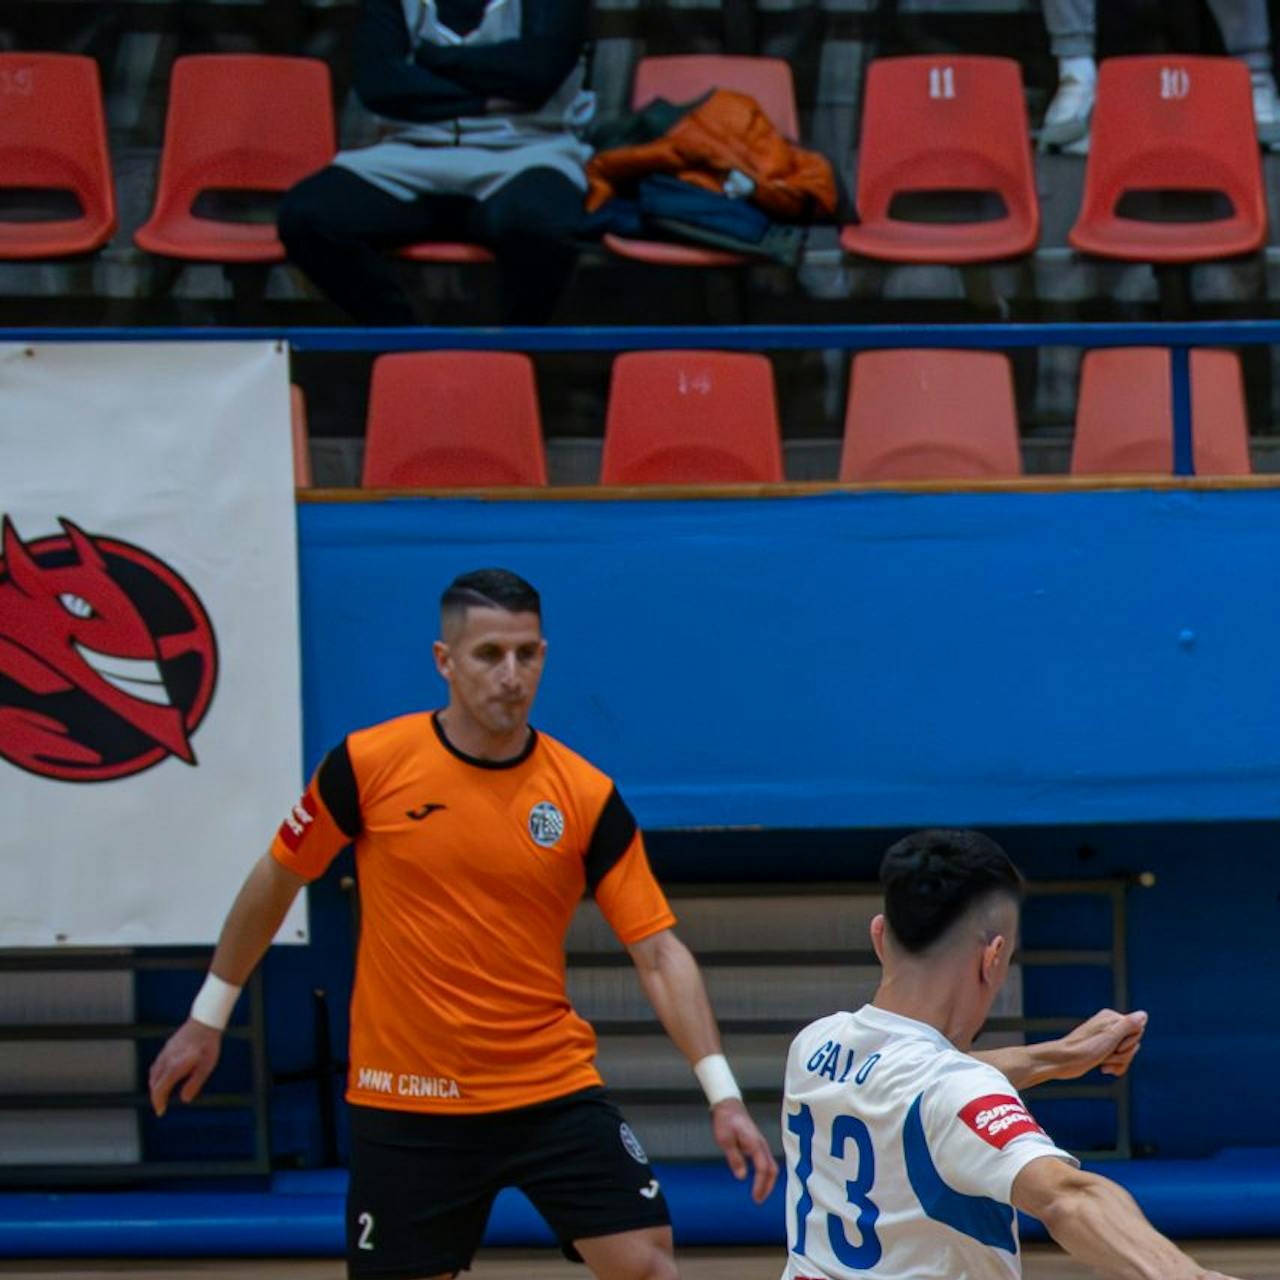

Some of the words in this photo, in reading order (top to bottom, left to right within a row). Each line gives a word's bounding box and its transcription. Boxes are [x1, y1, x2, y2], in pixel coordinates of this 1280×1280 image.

[929, 66, 956, 99] 11
[1160, 66, 1191, 100] 10
[357, 1067, 393, 1093] MNK
[398, 1073, 461, 1099] CRNICA
[787, 1102, 882, 1270] 13
[357, 1212, 375, 1251] 2
